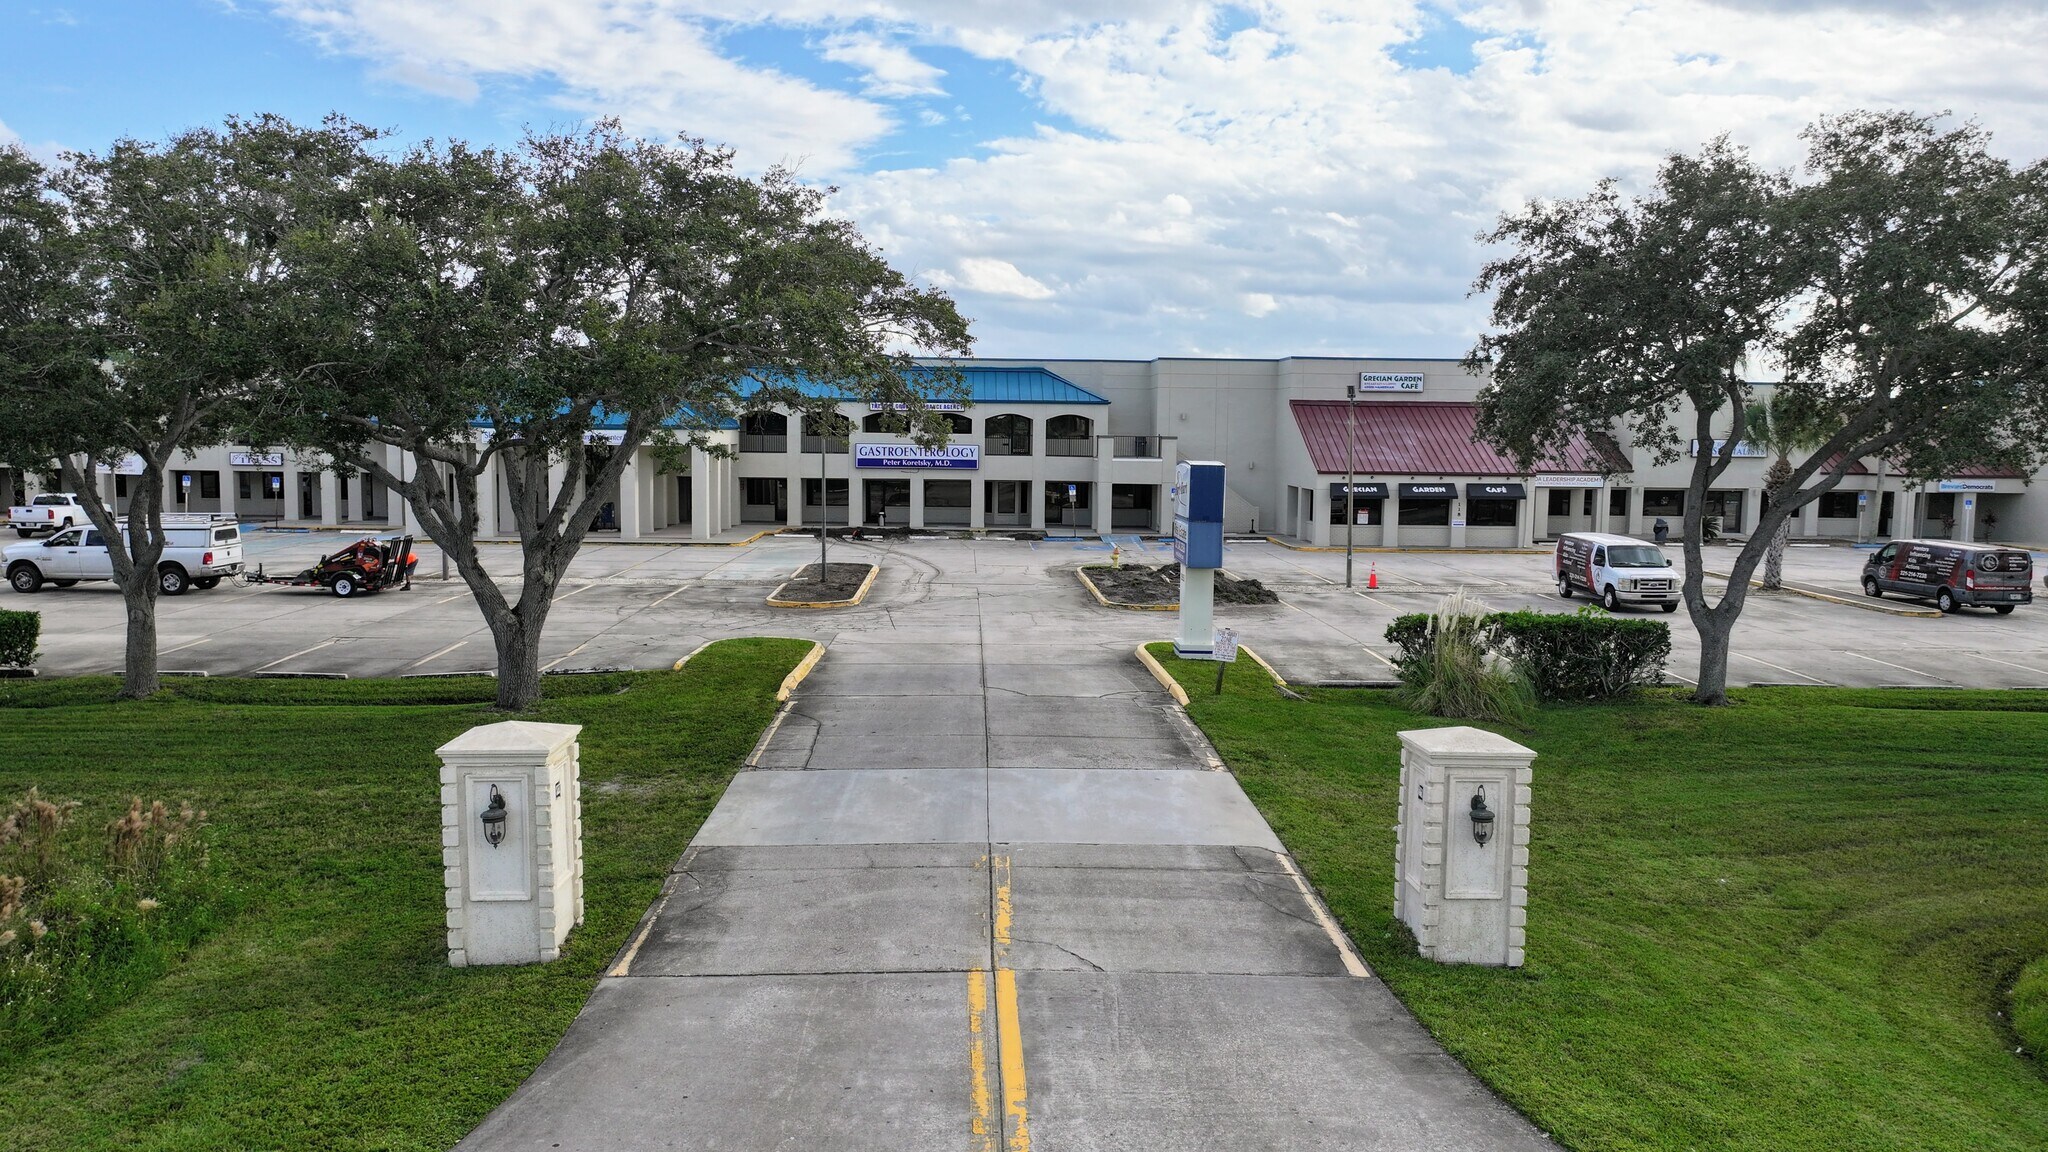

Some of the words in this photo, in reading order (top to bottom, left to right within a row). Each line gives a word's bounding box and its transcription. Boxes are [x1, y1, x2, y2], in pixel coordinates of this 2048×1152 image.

[859, 446, 976, 458] GASTROENTEROLOGY
[1712, 447, 1766, 455] SIALISTS
[902, 459, 934, 468] Koretsky,
[1909, 551, 1931, 560] Influencing
